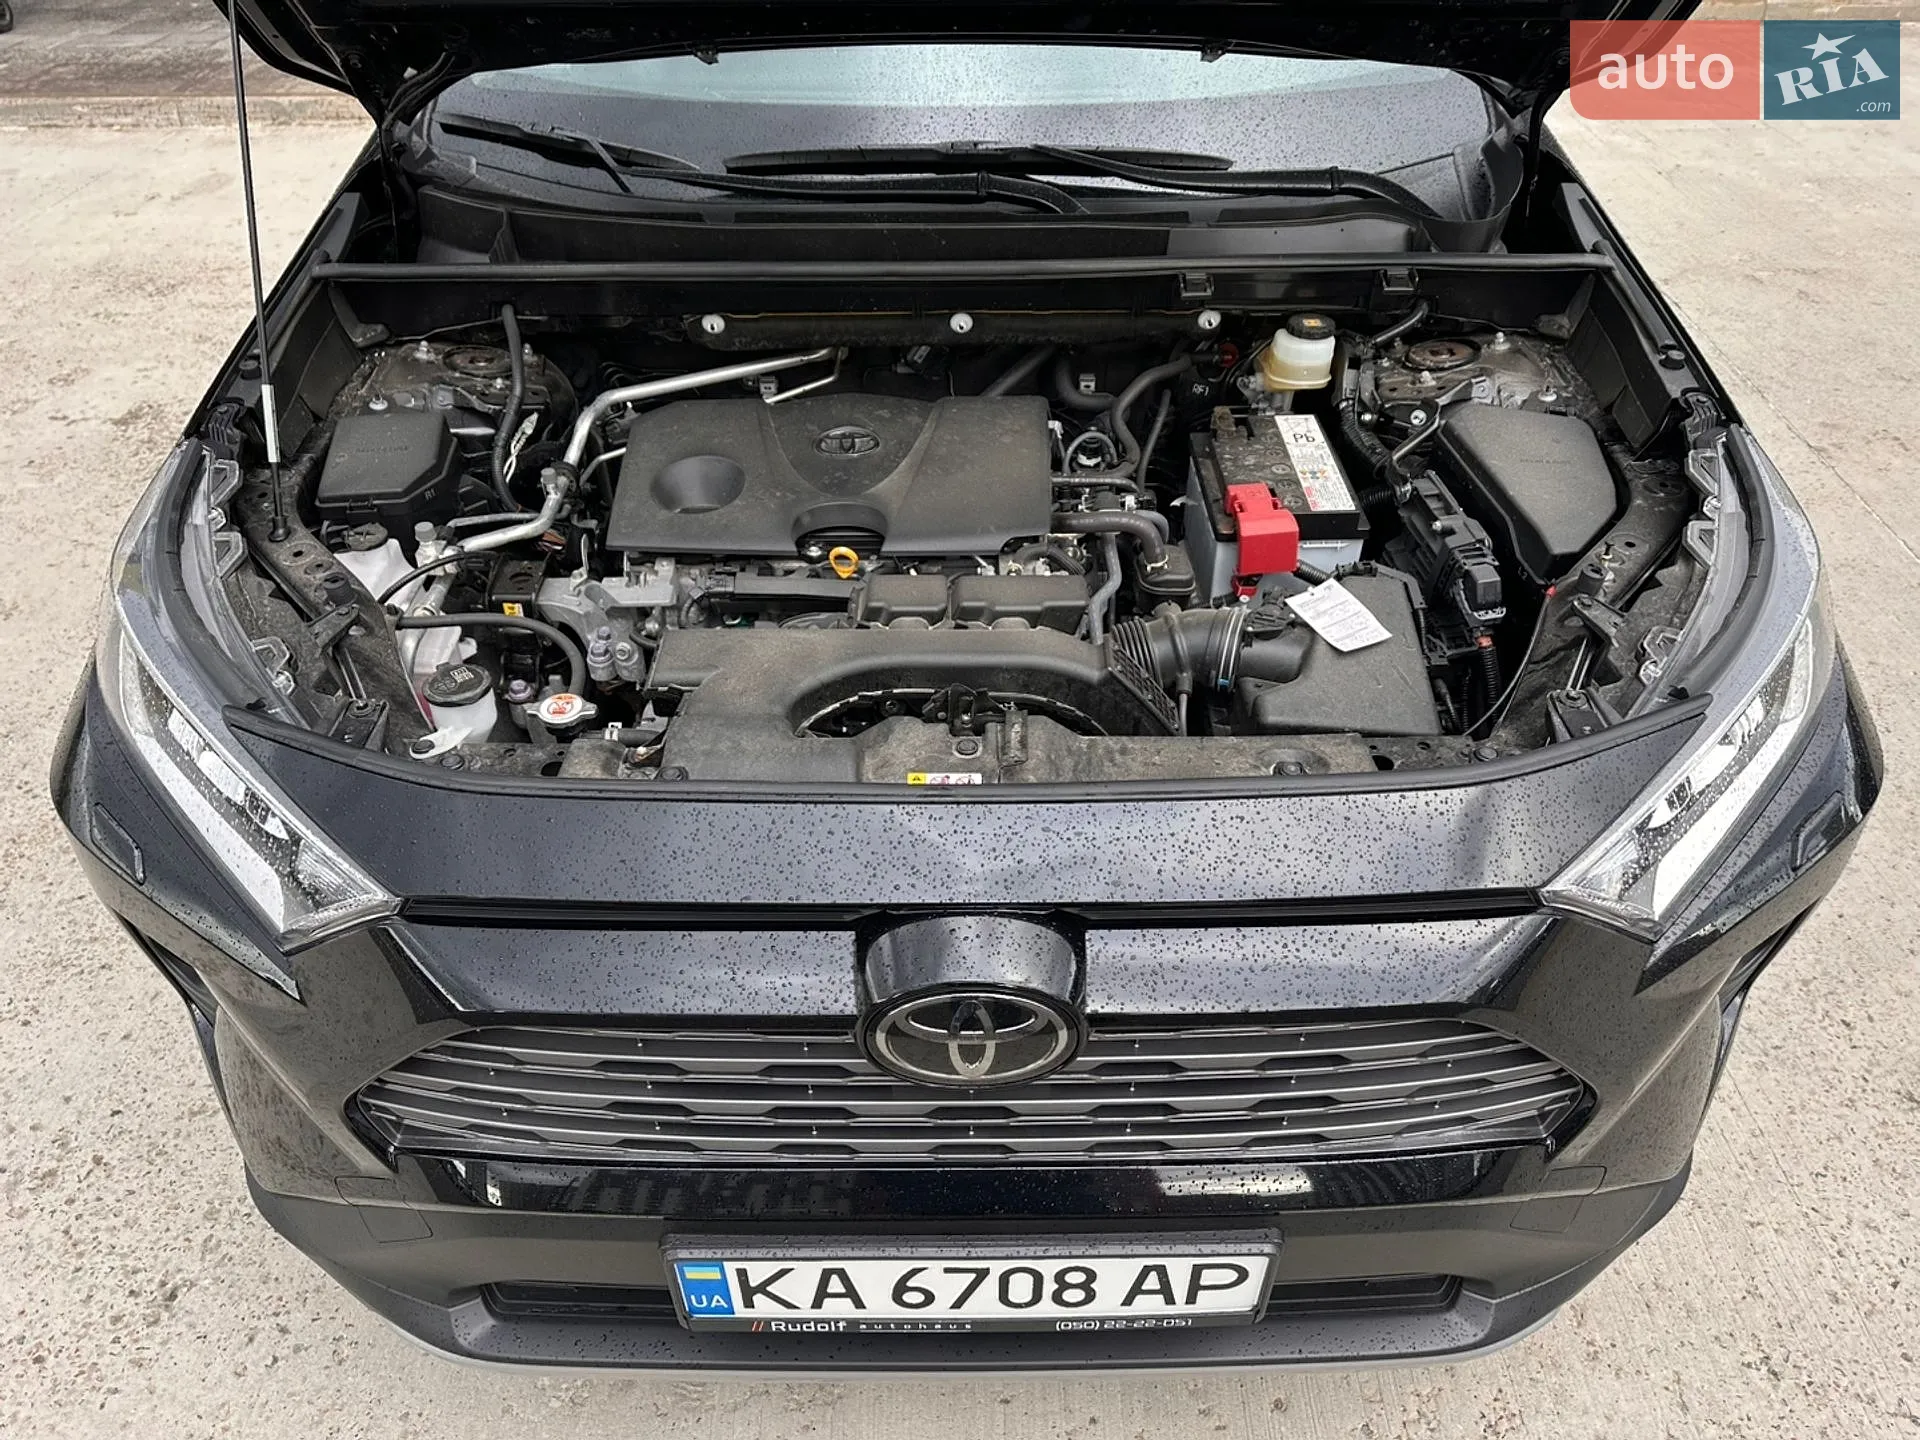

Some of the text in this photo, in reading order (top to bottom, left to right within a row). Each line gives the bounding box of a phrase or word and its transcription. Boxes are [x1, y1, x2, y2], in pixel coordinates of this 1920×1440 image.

[1293, 433, 1316, 443] Pb
[735, 1262, 1250, 1310] KA 6708 AP
[690, 1294, 729, 1309] UA
[770, 1320, 848, 1333] Rudolf
[1055, 1319, 1100, 1331] (050)
